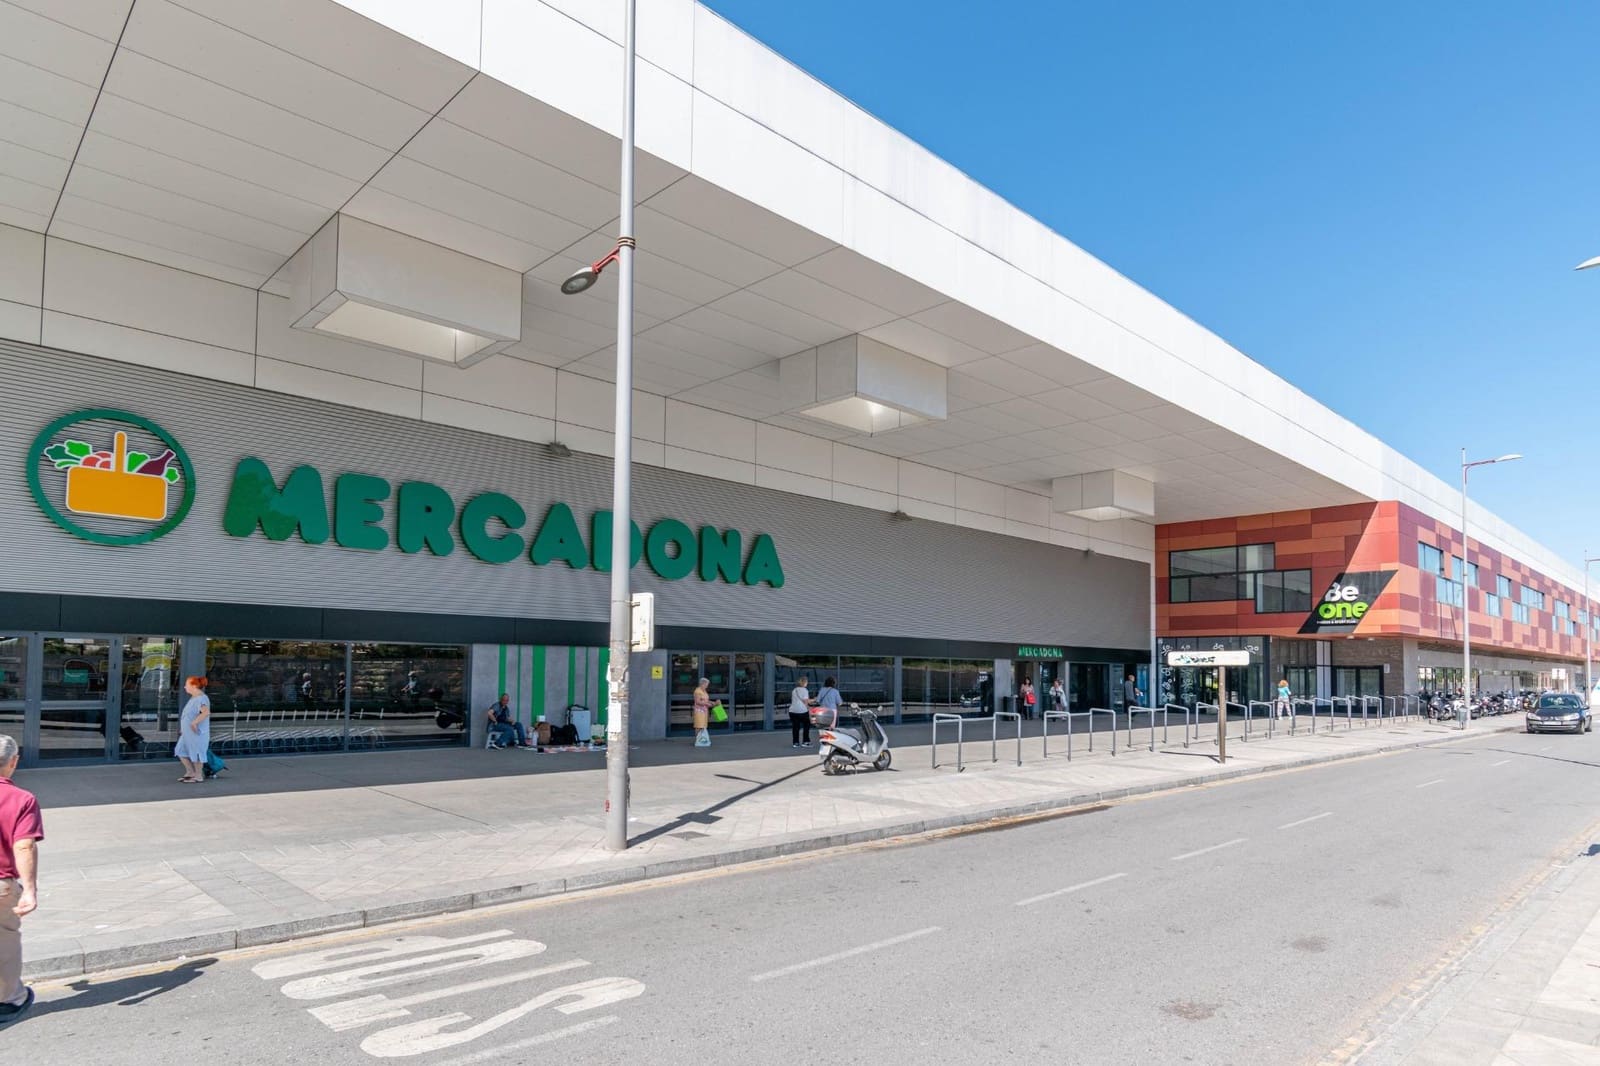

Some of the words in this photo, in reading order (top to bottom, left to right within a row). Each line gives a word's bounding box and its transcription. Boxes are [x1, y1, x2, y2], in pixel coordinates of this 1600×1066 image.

[1325, 582, 1360, 602] Be
[1319, 601, 1369, 619] one
[1018, 646, 1063, 658] MERCADONA
[251, 929, 646, 1058] STOP
